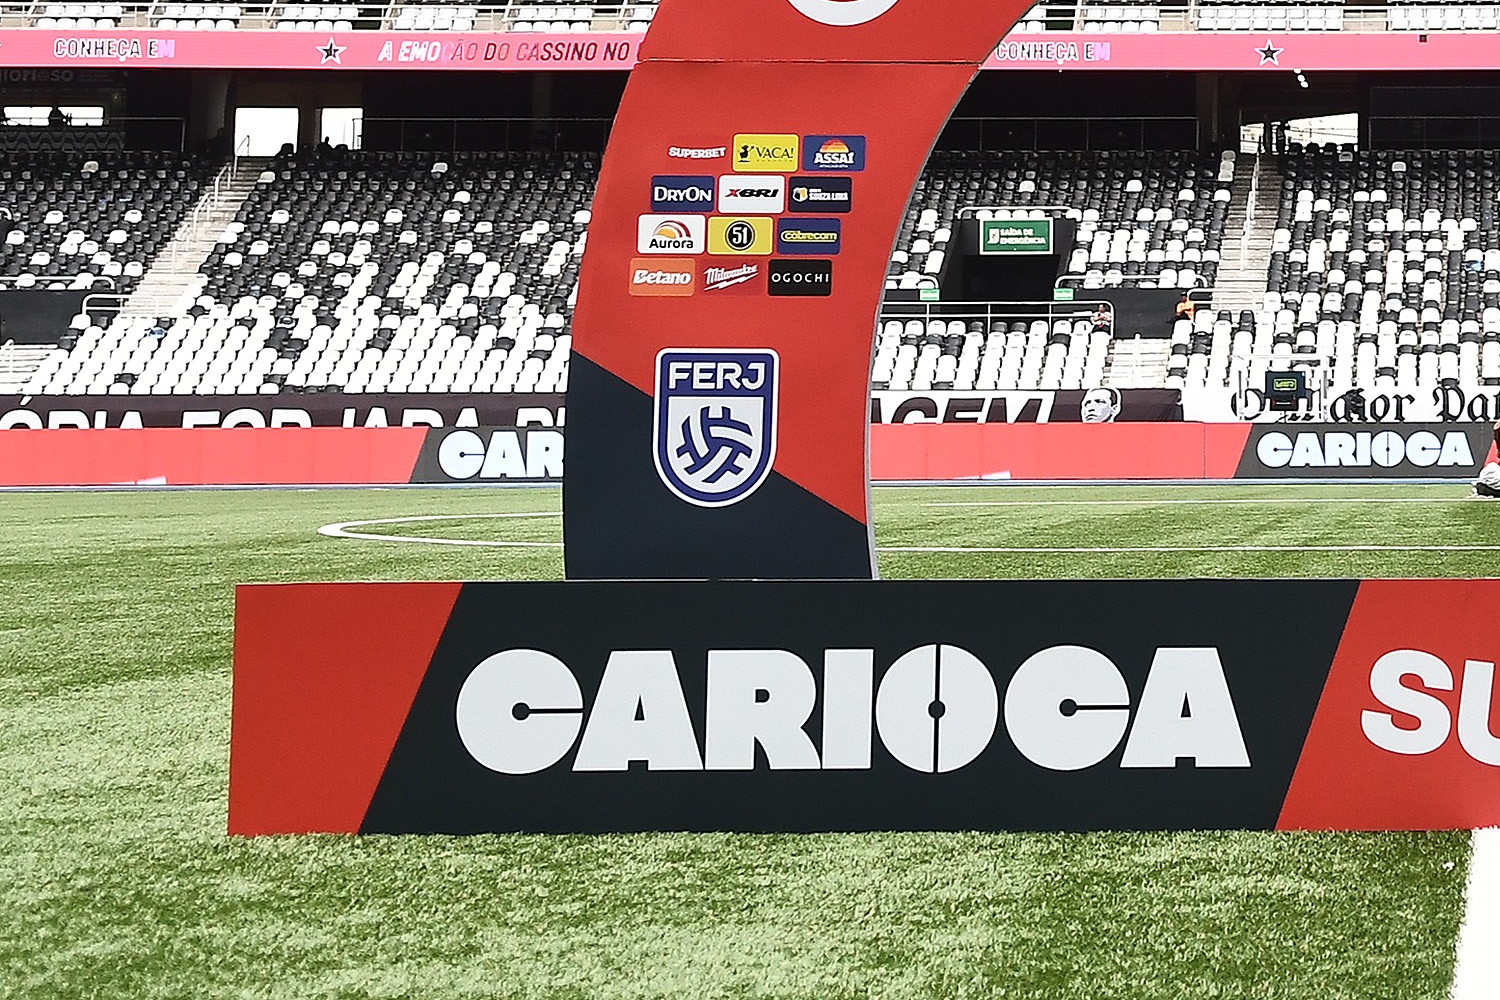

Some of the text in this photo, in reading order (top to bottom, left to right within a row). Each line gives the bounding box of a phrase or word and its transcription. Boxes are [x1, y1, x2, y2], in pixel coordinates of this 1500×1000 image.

[54, 37, 141, 62] CONHEÇA
[377, 40, 393, 62] A
[484, 41, 510, 61] DO
[516, 41, 597, 61] CASSINO
[602, 41, 630, 61] NO
[995, 41, 1079, 64] CONHEÇA
[669, 145, 727, 159] SUPERBET
[755, 146, 794, 159] VACA!
[724, 188, 779, 198] XBRI
[649, 238, 694, 249] Aurora
[732, 226, 749, 244] 51
[633, 269, 692, 285] Betano
[771, 272, 830, 283] OGOCHI
[668, 361, 766, 390] FERJ
[1256, 430, 1475, 468] CARIOCA
[455, 642, 1252, 775] CARIOCA
